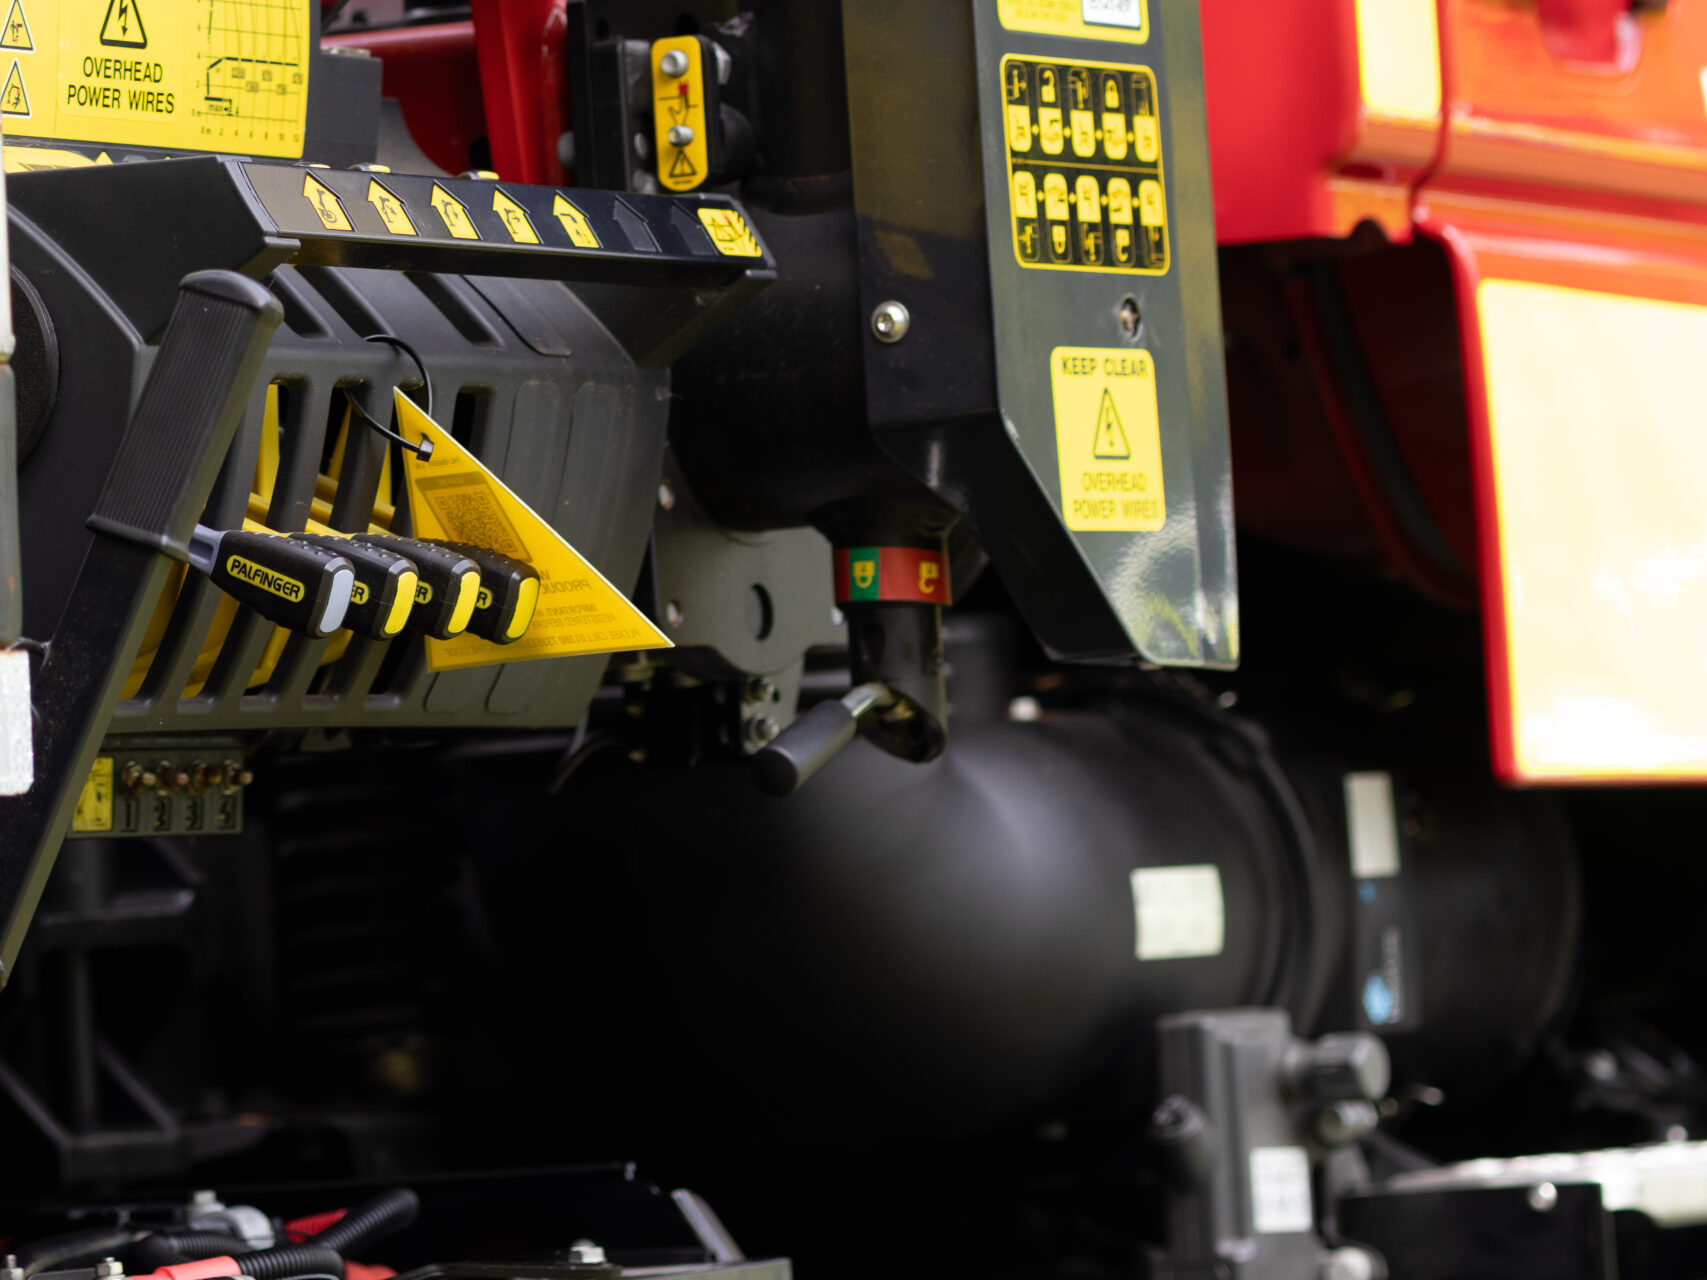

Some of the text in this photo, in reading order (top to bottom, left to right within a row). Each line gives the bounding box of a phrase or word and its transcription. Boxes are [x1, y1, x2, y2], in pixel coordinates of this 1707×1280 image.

[83, 56, 163, 83] OVERHEAD
[67, 84, 175, 114] POWER WIRES
[1062, 356, 1148, 377] KEEP CLEAR
[1082, 471, 1147, 492] OVERHEAD
[1073, 499, 1161, 520] POWER WIRES
[230, 558, 300, 601] PALFINGER
